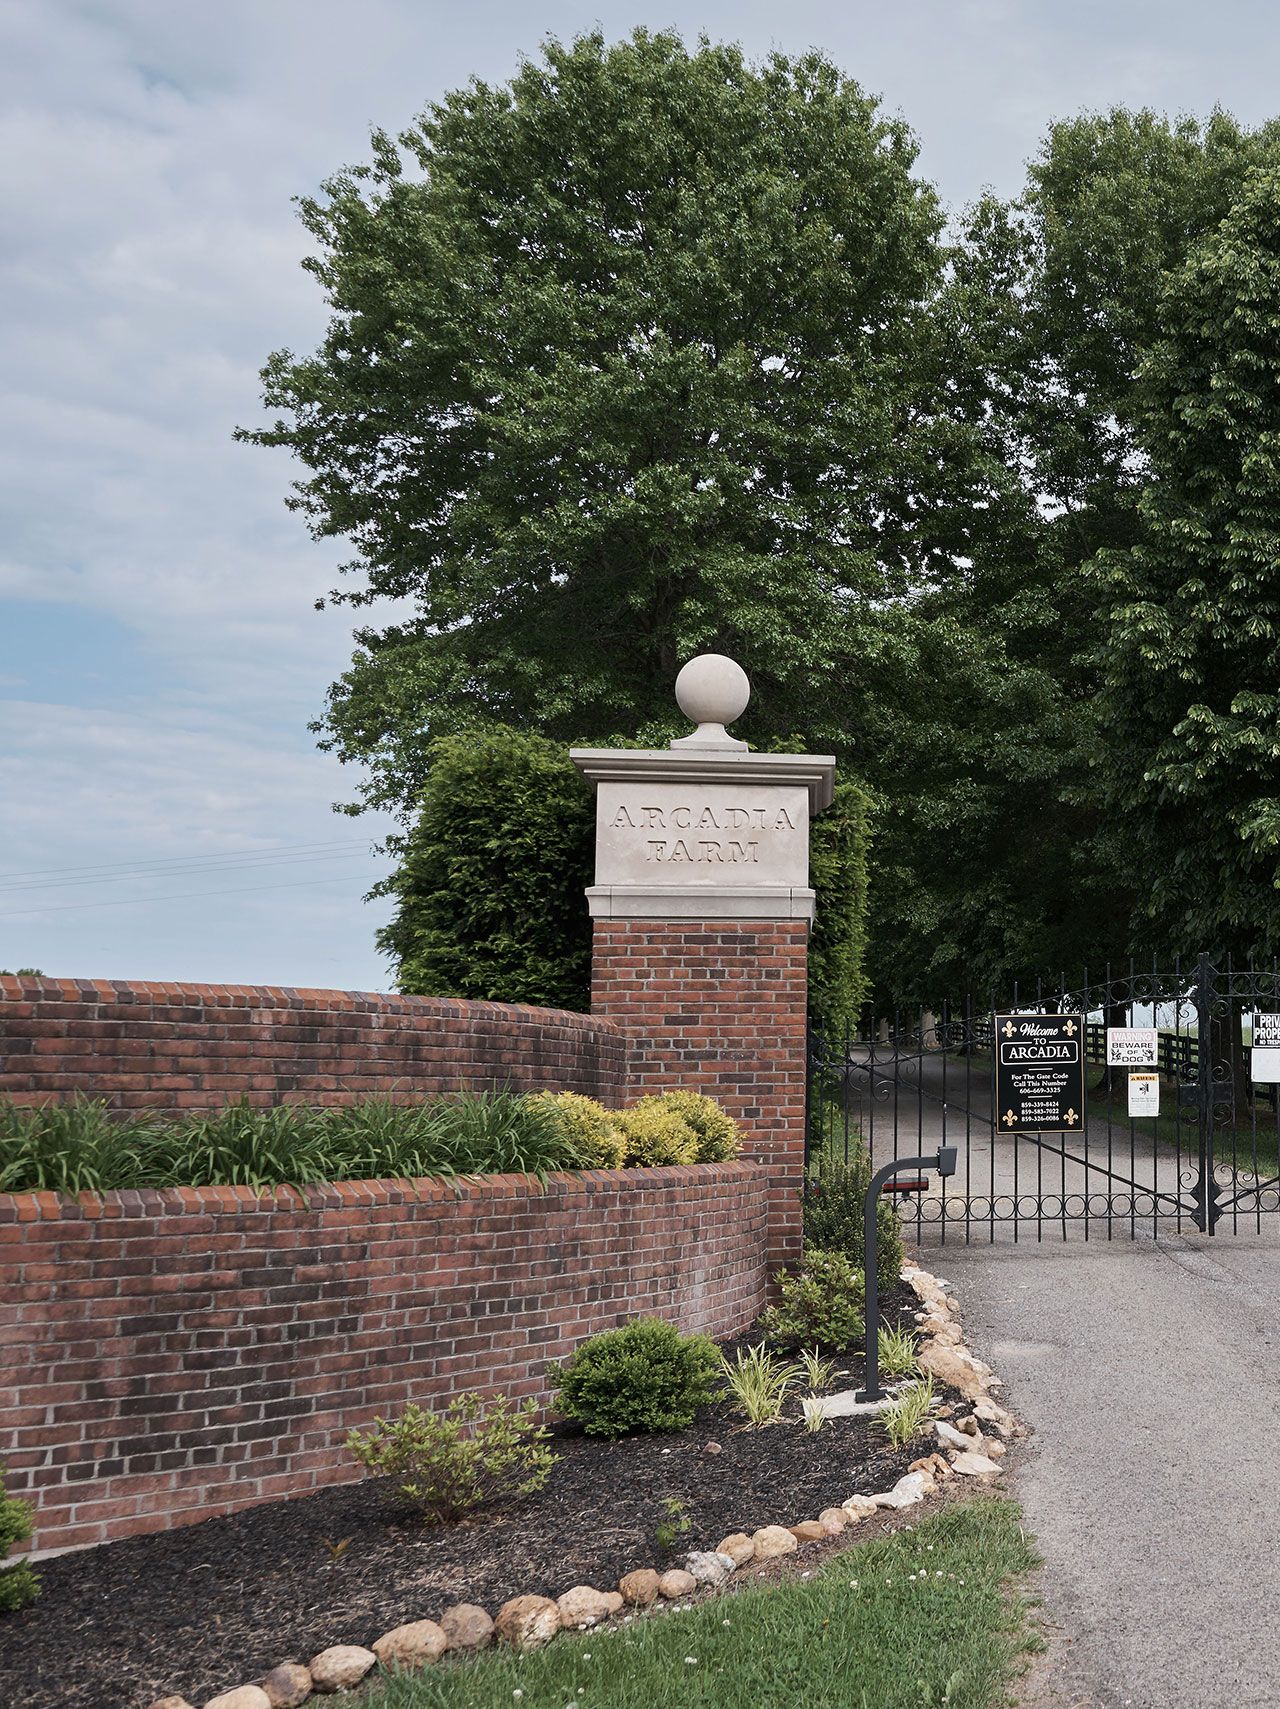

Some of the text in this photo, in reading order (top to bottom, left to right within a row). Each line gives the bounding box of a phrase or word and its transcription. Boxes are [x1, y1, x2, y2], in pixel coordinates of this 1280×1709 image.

[609, 806, 795, 830] ARCADIA
[646, 840, 759, 862] FARM
[1020, 1022, 1058, 1036] Welcome
[1113, 1032, 1152, 1040] WARNING
[1008, 1046, 1070, 1058] ARCADIA
